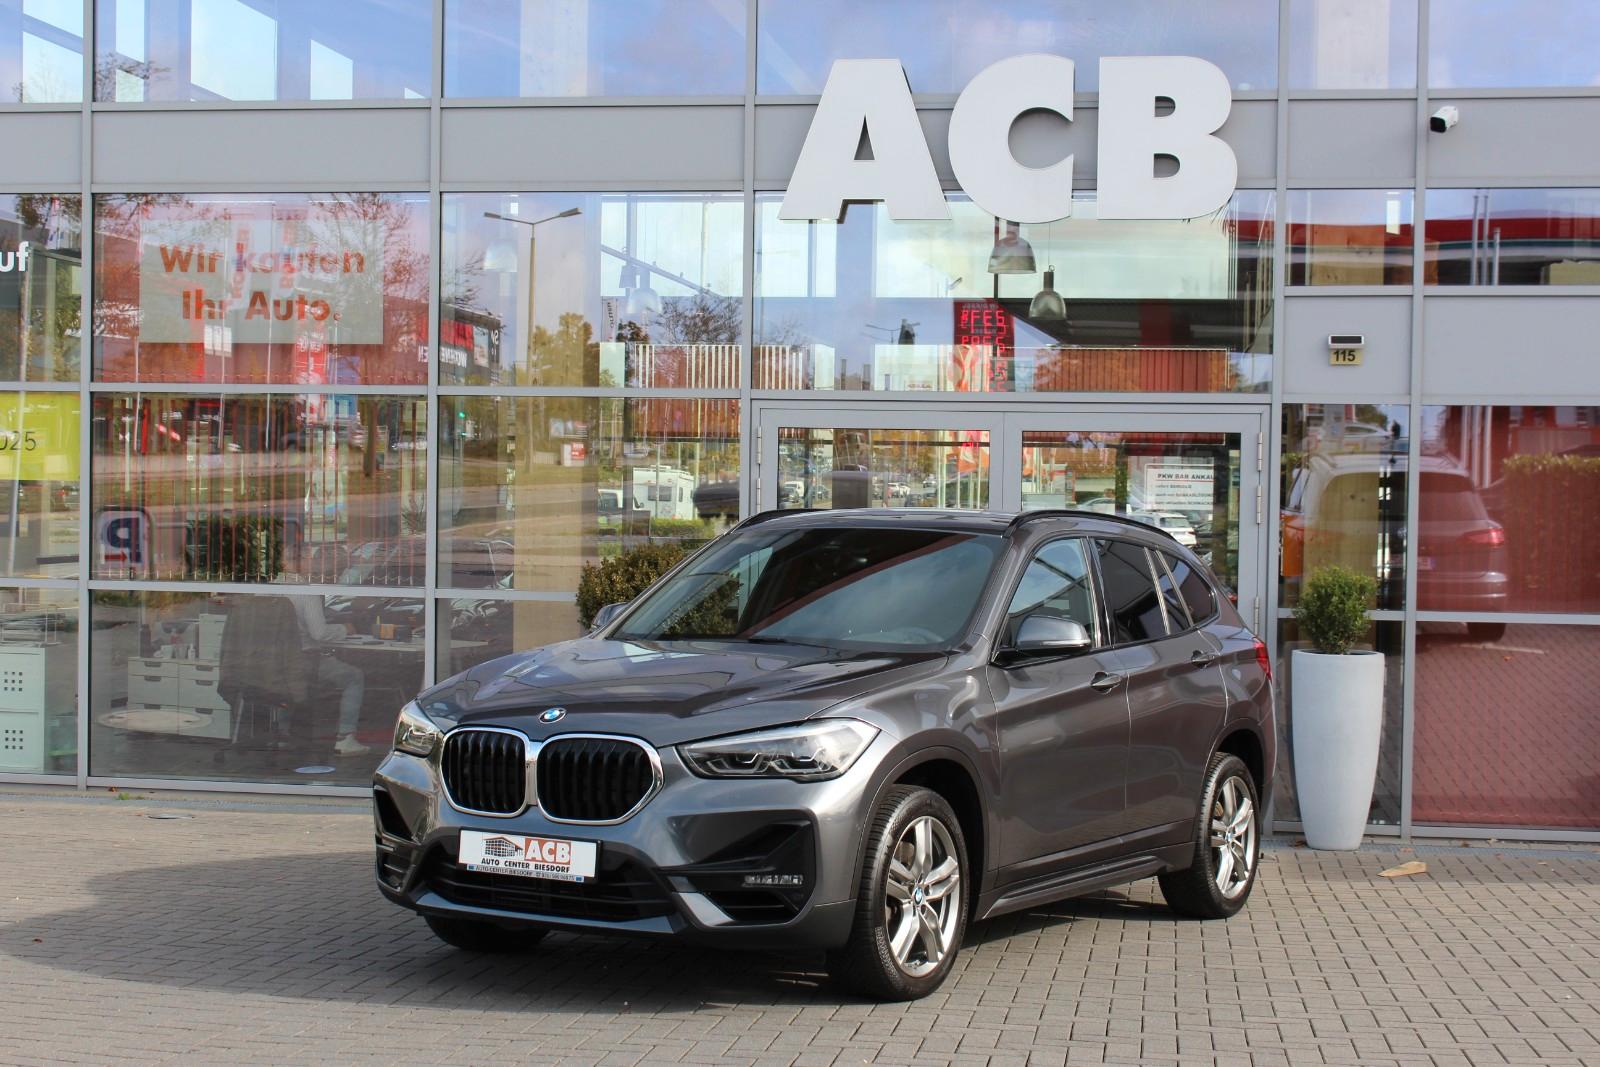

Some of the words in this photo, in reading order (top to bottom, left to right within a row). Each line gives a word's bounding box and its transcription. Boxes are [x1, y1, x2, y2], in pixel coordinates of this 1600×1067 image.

[777, 53, 1238, 224] ACB
[160, 244, 224, 273] Wir
[182, 288, 229, 320] Ihr
[244, 291, 342, 321] Auto.
[1333, 350, 1356, 362] 115
[525, 839, 570, 863] ACB
[481, 857, 500, 866] AUTO
[504, 860, 530, 870] CENTER
[534, 863, 570, 873] BIESDORF
